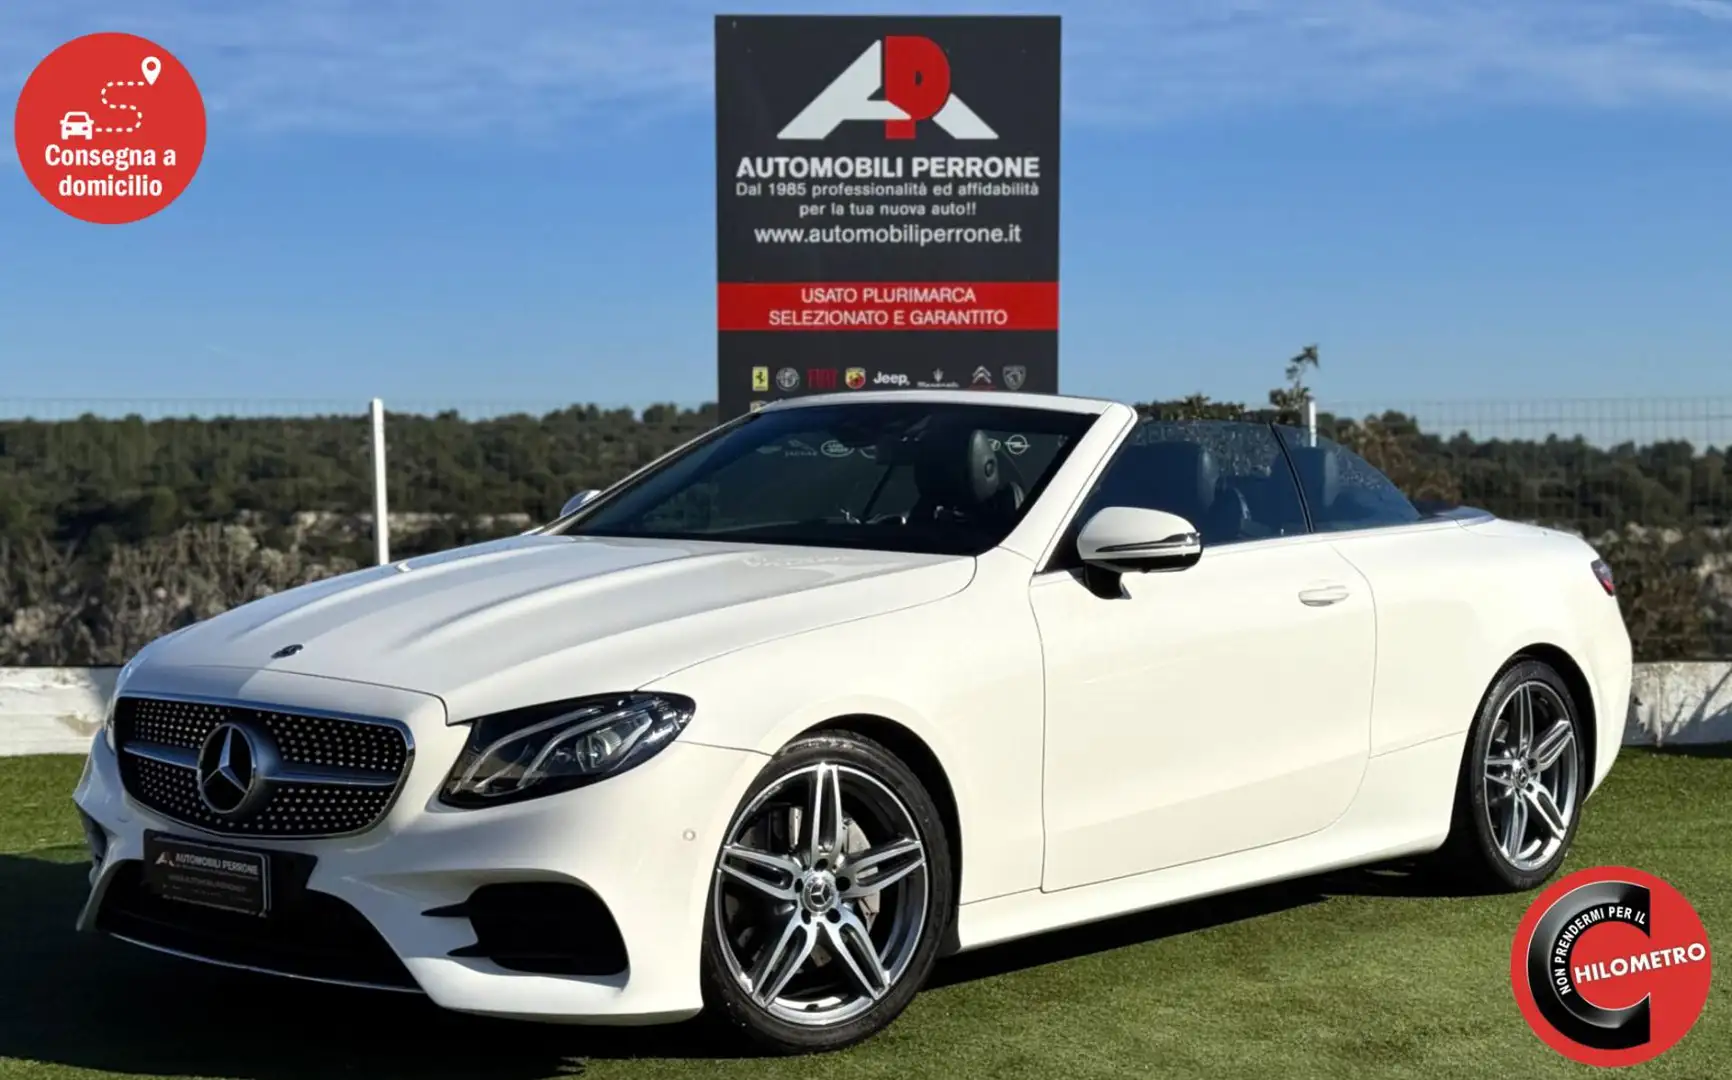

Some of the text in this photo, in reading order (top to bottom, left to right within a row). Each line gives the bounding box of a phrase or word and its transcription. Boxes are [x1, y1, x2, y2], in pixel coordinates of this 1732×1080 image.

[736, 156, 1040, 178] AUTOMOBILI PERRONE
[736, 181, 1039, 199] Dal 1985 professionalità ed affidabilità
[799, 202, 977, 218] per la tua nuova auto!!
[754, 224, 1022, 247] www.automobiliperrone.it
[800, 287, 977, 304] USATO PLURIMARCA
[768, 309, 1008, 326] SELEZIONATO E GARANTITO
